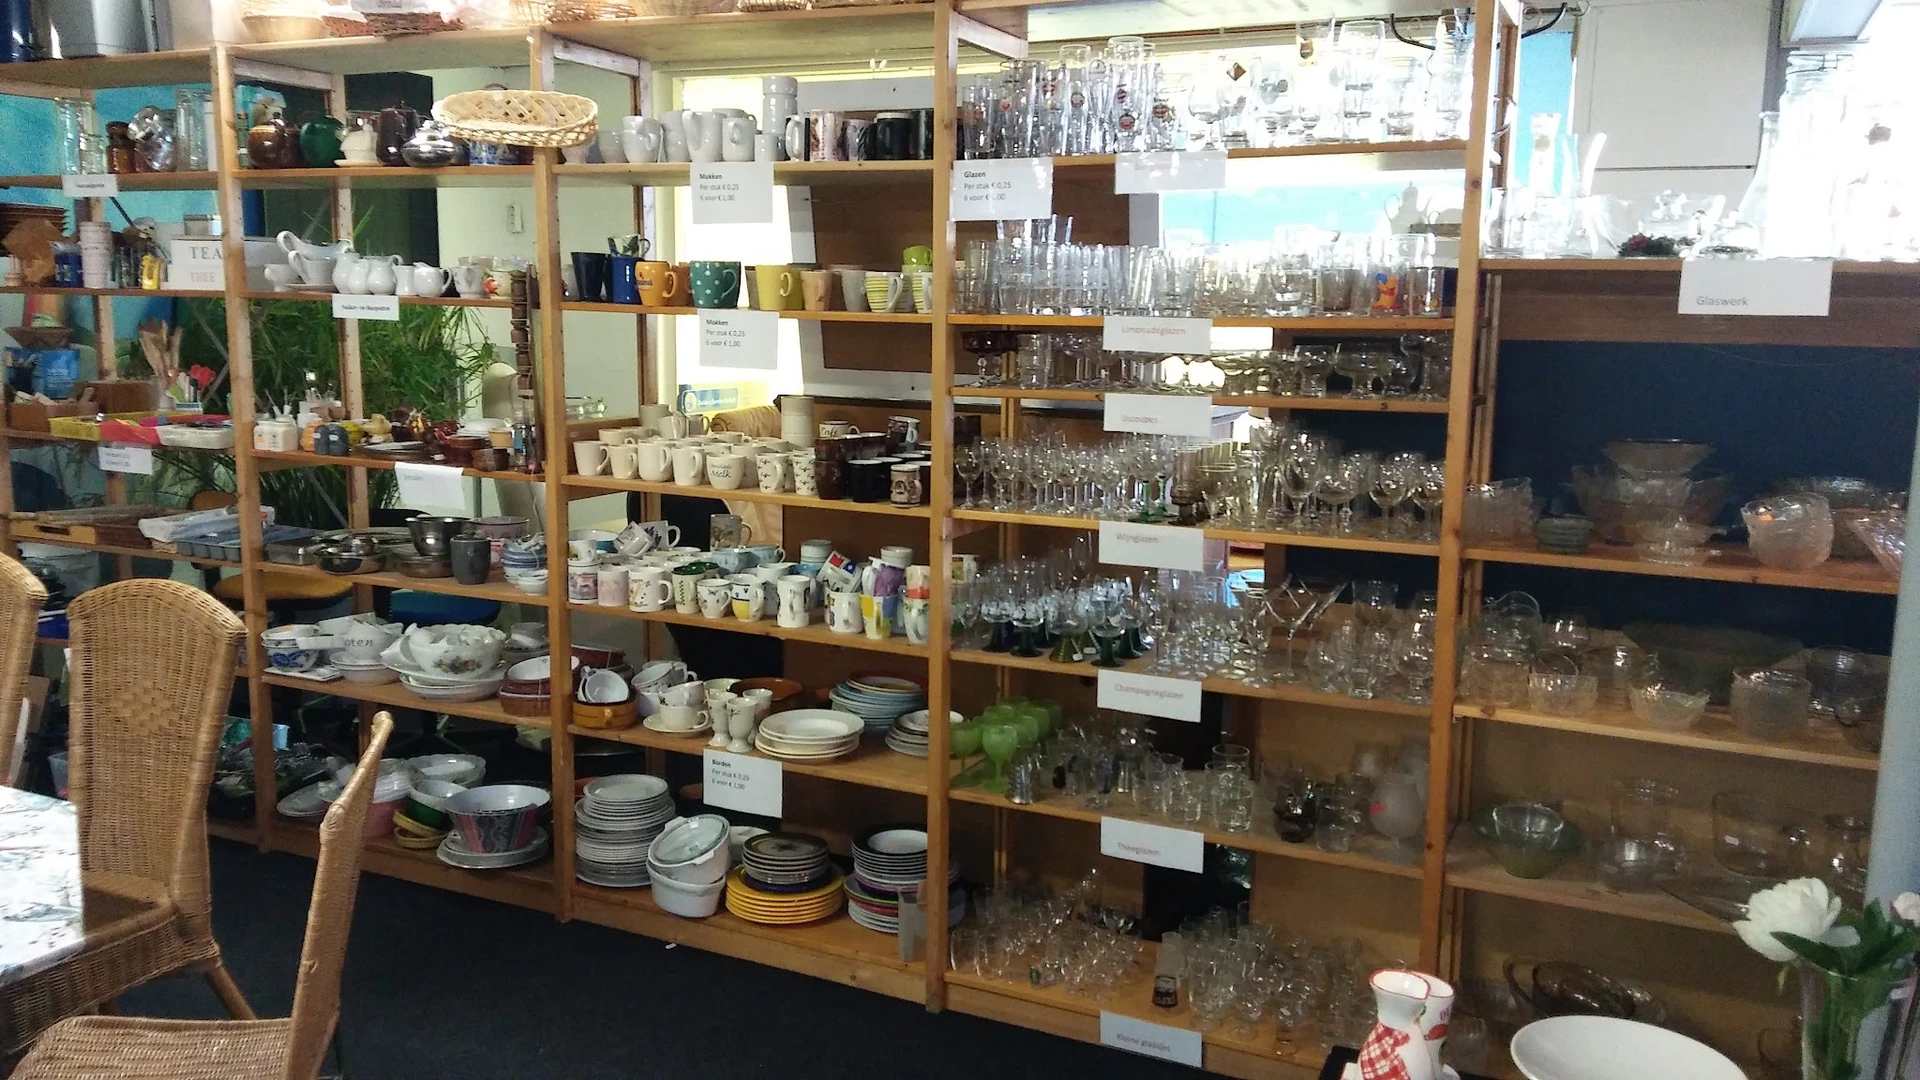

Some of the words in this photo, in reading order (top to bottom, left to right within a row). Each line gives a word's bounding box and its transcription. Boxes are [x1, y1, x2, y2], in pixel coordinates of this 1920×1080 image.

[188, 246, 223, 260] TEA
[1696, 296, 1749, 306] Glaswerk
[1121, 325, 1186, 336] Limonadeglazen
[1116, 533, 1159, 544] Wijnglazen
[1114, 684, 1184, 699] Champagneglazen
[711, 758, 732, 768] Borden
[711, 768, 720, 776] Per
[1117, 842, 1160, 856] Theeglazen
